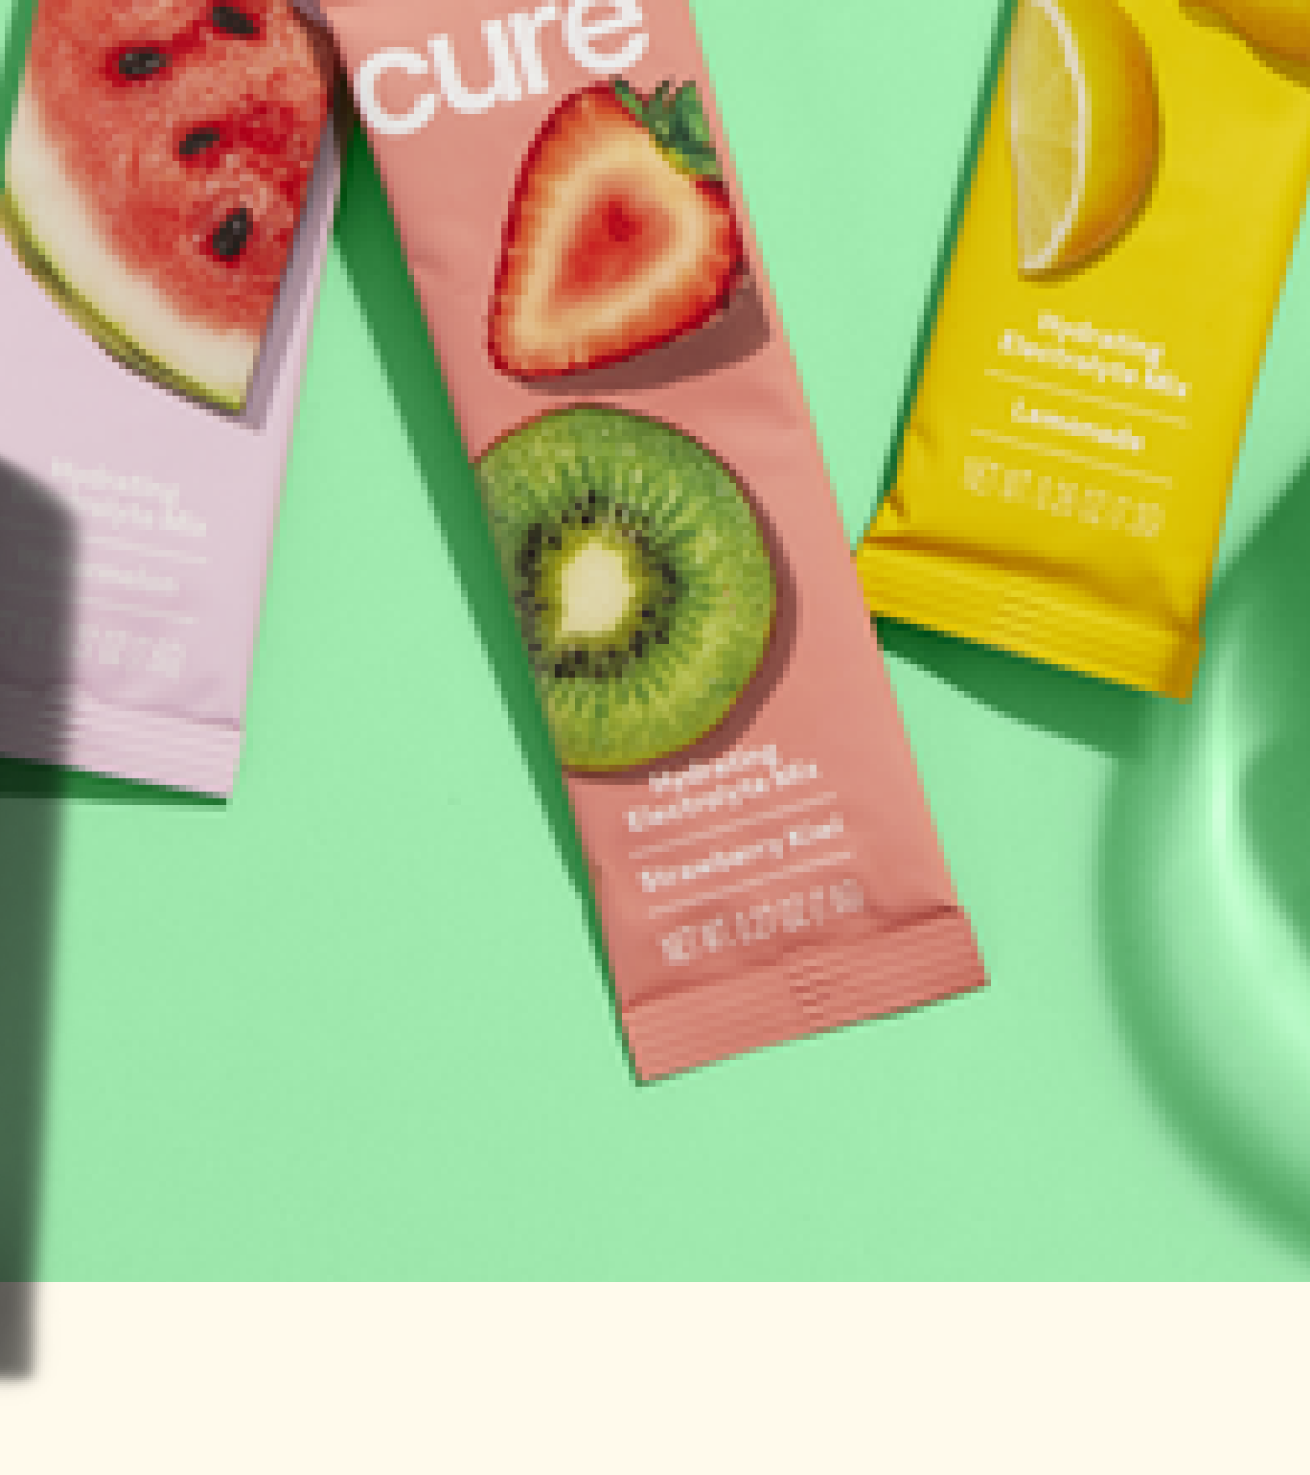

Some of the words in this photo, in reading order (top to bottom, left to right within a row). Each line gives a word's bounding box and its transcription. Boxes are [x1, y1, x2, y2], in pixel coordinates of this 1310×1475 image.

[1037, 308, 1166, 370] Hydrating
[1011, 396, 1146, 456] Lemonade
[649, 744, 777, 799] Hydrating
